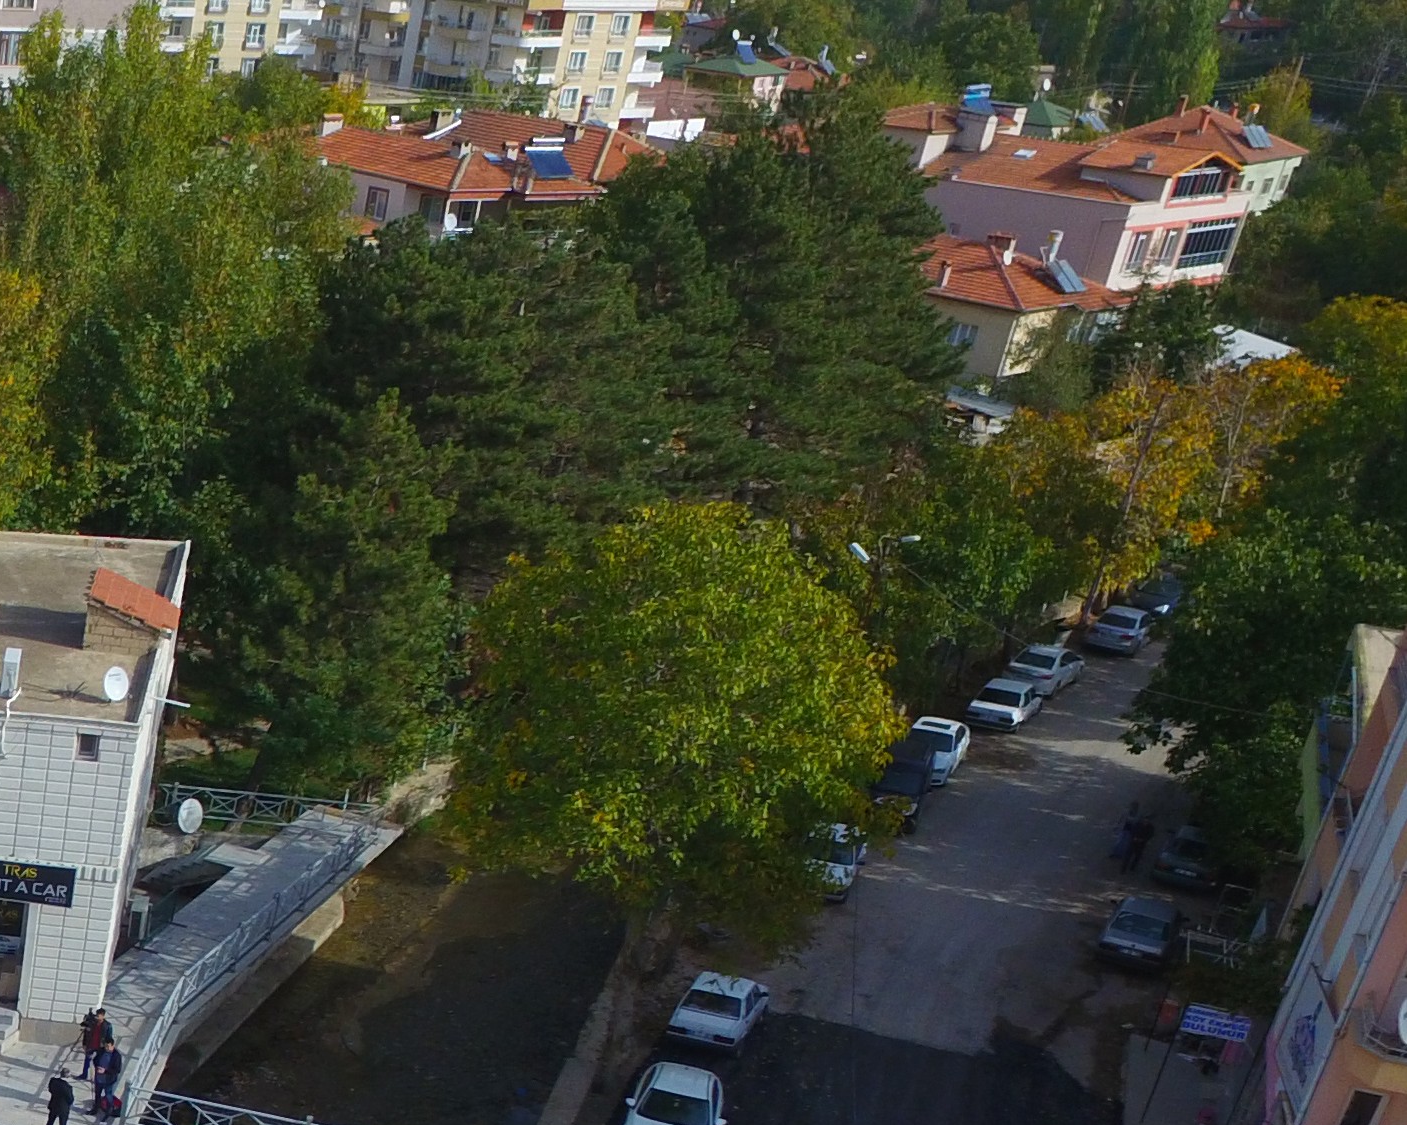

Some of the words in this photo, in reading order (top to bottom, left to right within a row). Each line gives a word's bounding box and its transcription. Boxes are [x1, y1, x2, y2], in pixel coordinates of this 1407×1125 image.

[2, 864, 38, 879] TRAS
[14, 881, 28, 895] A
[32, 882, 68, 898] CAR
